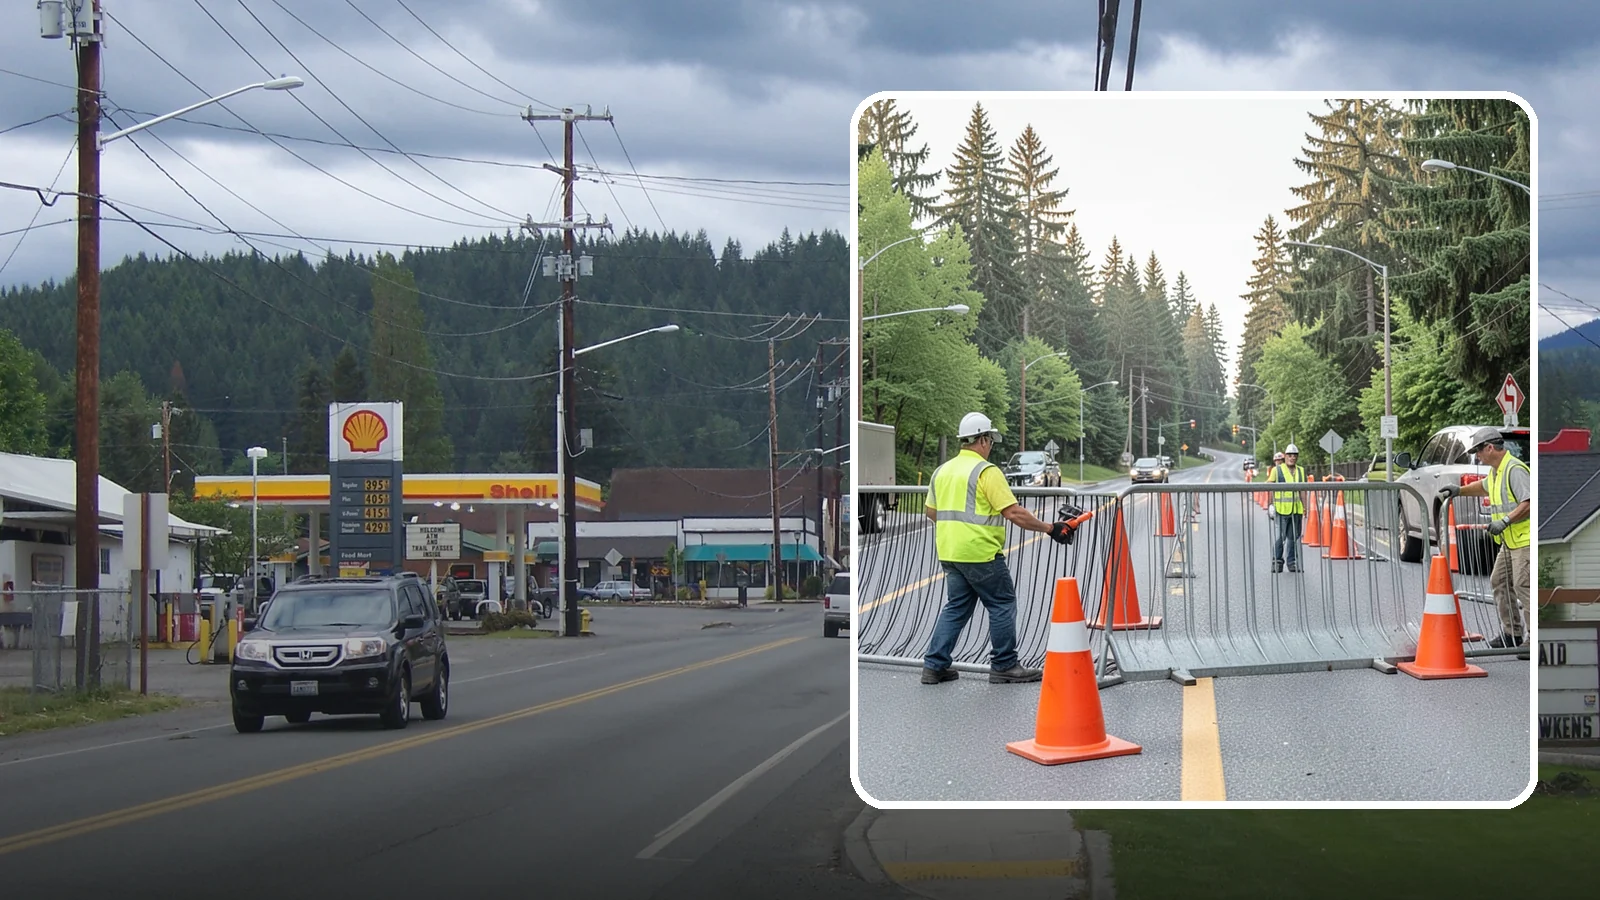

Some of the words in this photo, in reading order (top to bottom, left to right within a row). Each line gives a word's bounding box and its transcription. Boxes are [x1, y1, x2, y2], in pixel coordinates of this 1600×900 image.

[366, 480, 384, 490] 395
[490, 484, 547, 499] Shell
[366, 494, 384, 504] 405
[366, 508, 383, 518] 415
[366, 522, 384, 533] 429
[1538, 643, 1567, 665] AID
